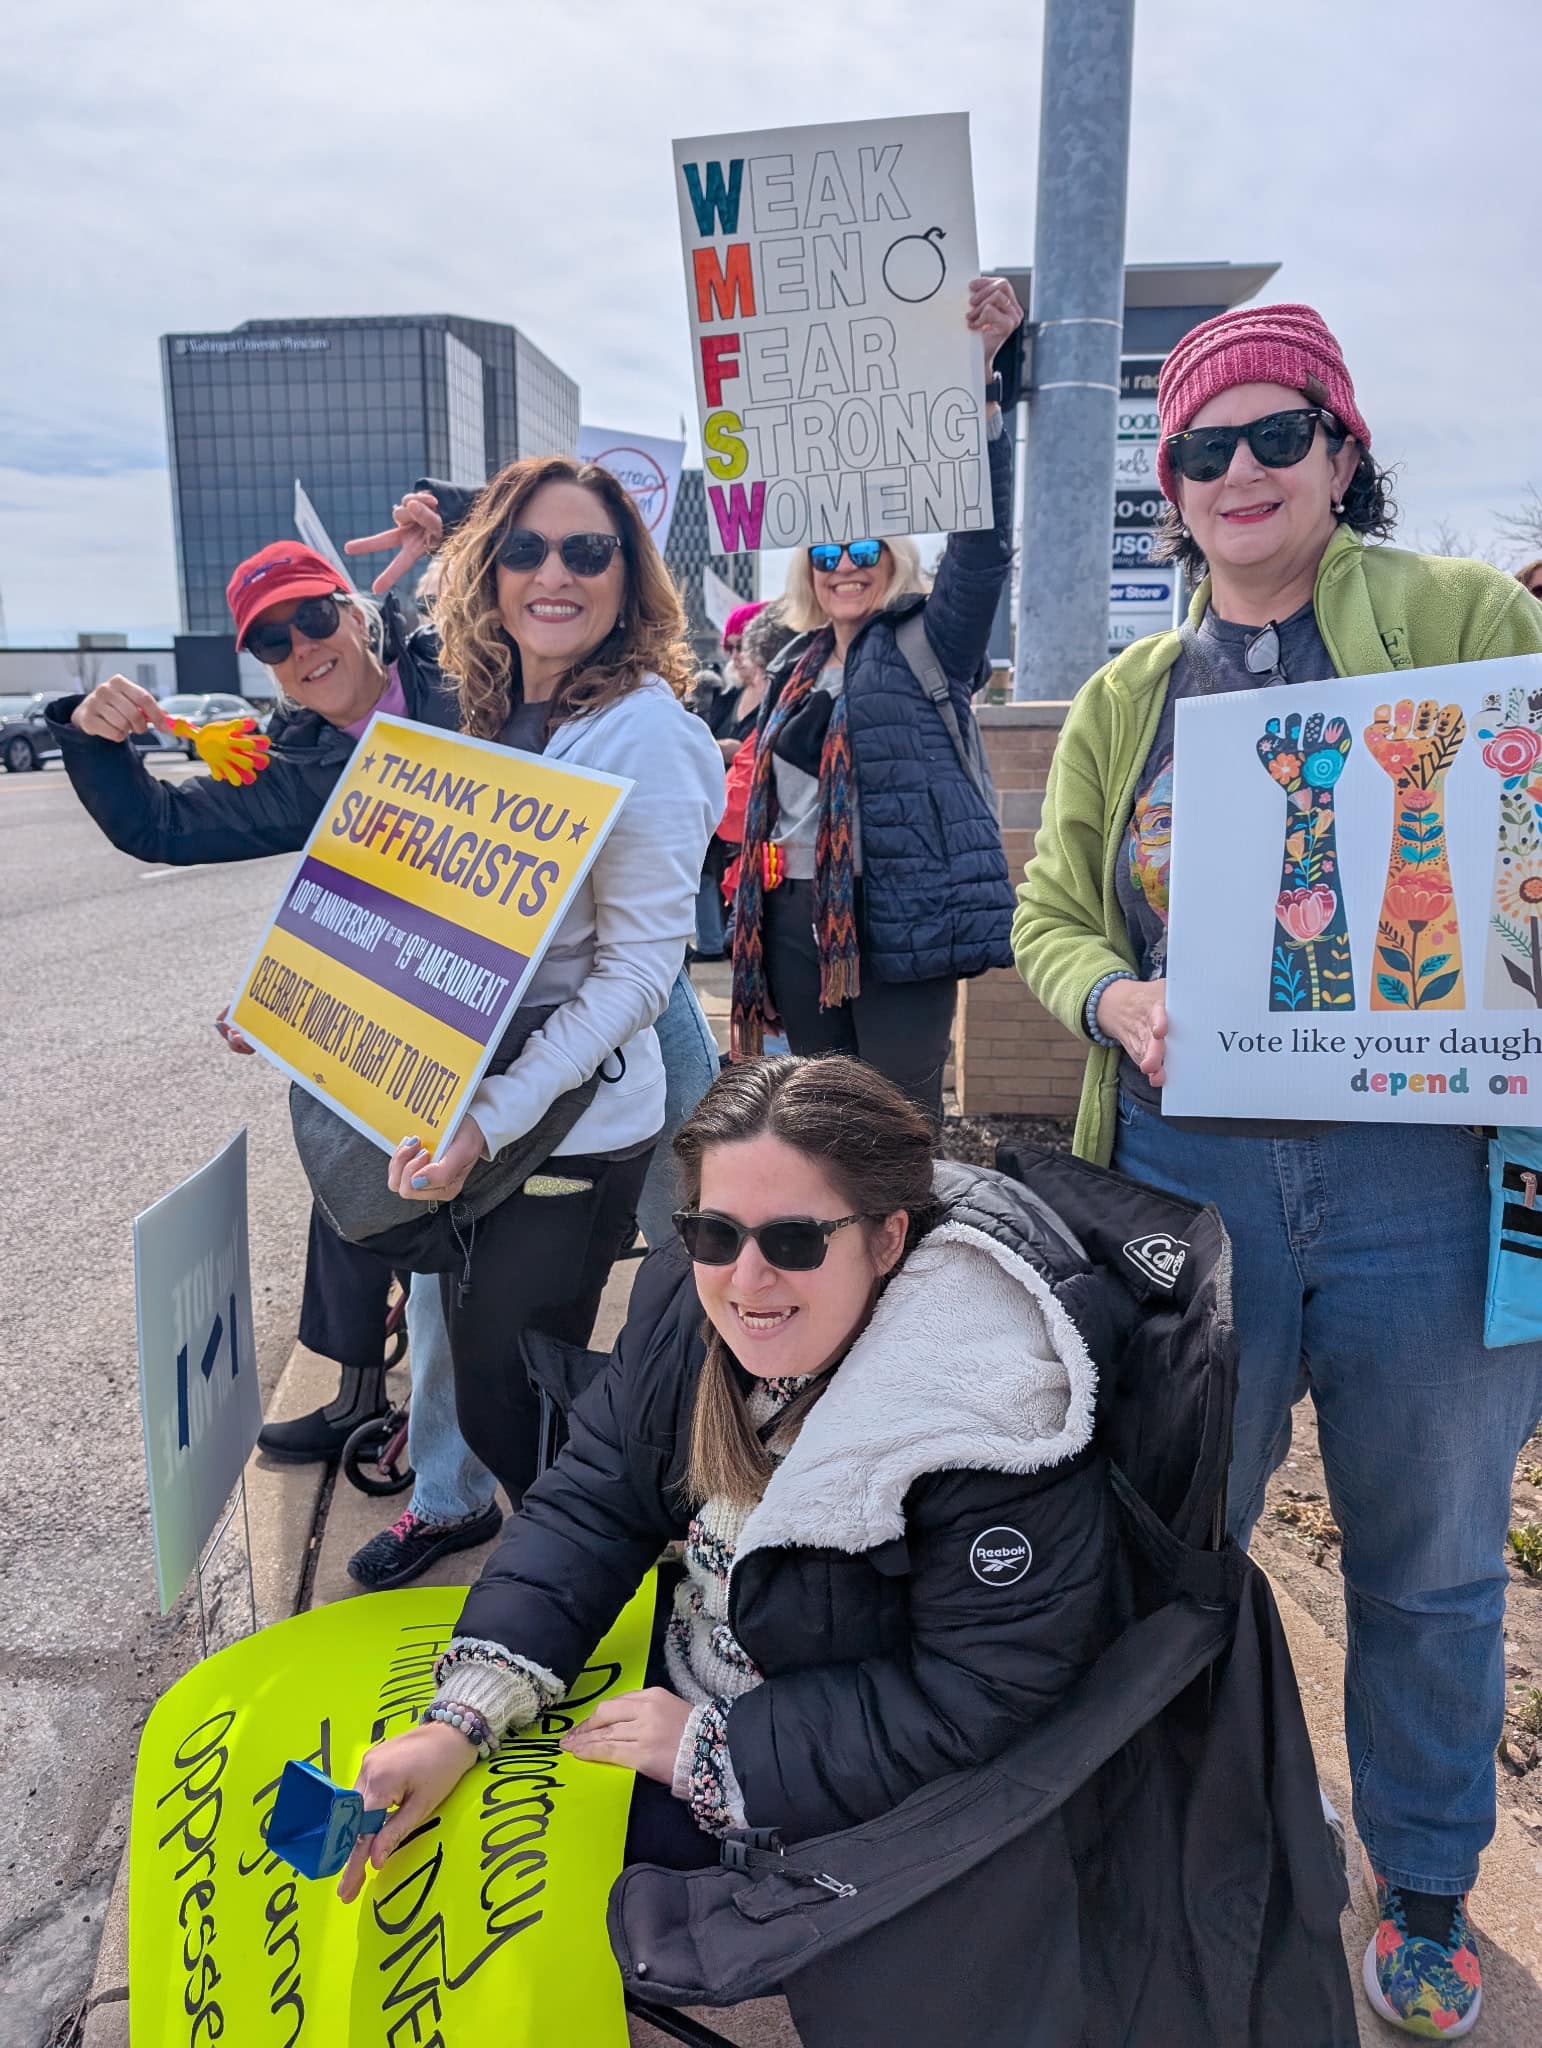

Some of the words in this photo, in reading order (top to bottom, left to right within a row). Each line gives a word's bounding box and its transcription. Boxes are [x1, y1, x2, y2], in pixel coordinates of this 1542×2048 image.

[683, 144, 911, 236] WEAK
[692, 231, 866, 323] MEN
[700, 317, 898, 408] FEAR
[704, 387, 980, 480] STRONG
[708, 458, 983, 553] WOMEN!
[377, 753, 490, 816] THANK
[490, 788, 570, 841] YOU
[331, 790, 560, 916] SUFFRAGISTS
[310, 890, 390, 952] ANNIVERSARY
[414, 944, 509, 1016] AMENDMENT
[249, 956, 314, 1028] CELEBRATE
[299, 987, 365, 1062] WOMEN'S
[348, 1021, 402, 1087] RIGHT
[386, 1044, 419, 1100] TO
[404, 1056, 460, 1128] VOTE!
[1217, 1031, 1282, 1053] Vote
[1290, 1028, 1346, 1053] like
[1354, 1036, 1430, 1060] your
[1351, 1067, 1470, 1097] depend
[1489, 1074, 1528, 1095] on
[977, 1546, 1025, 1558] Reebok
[373, 1841, 447, 2048] DIVE
